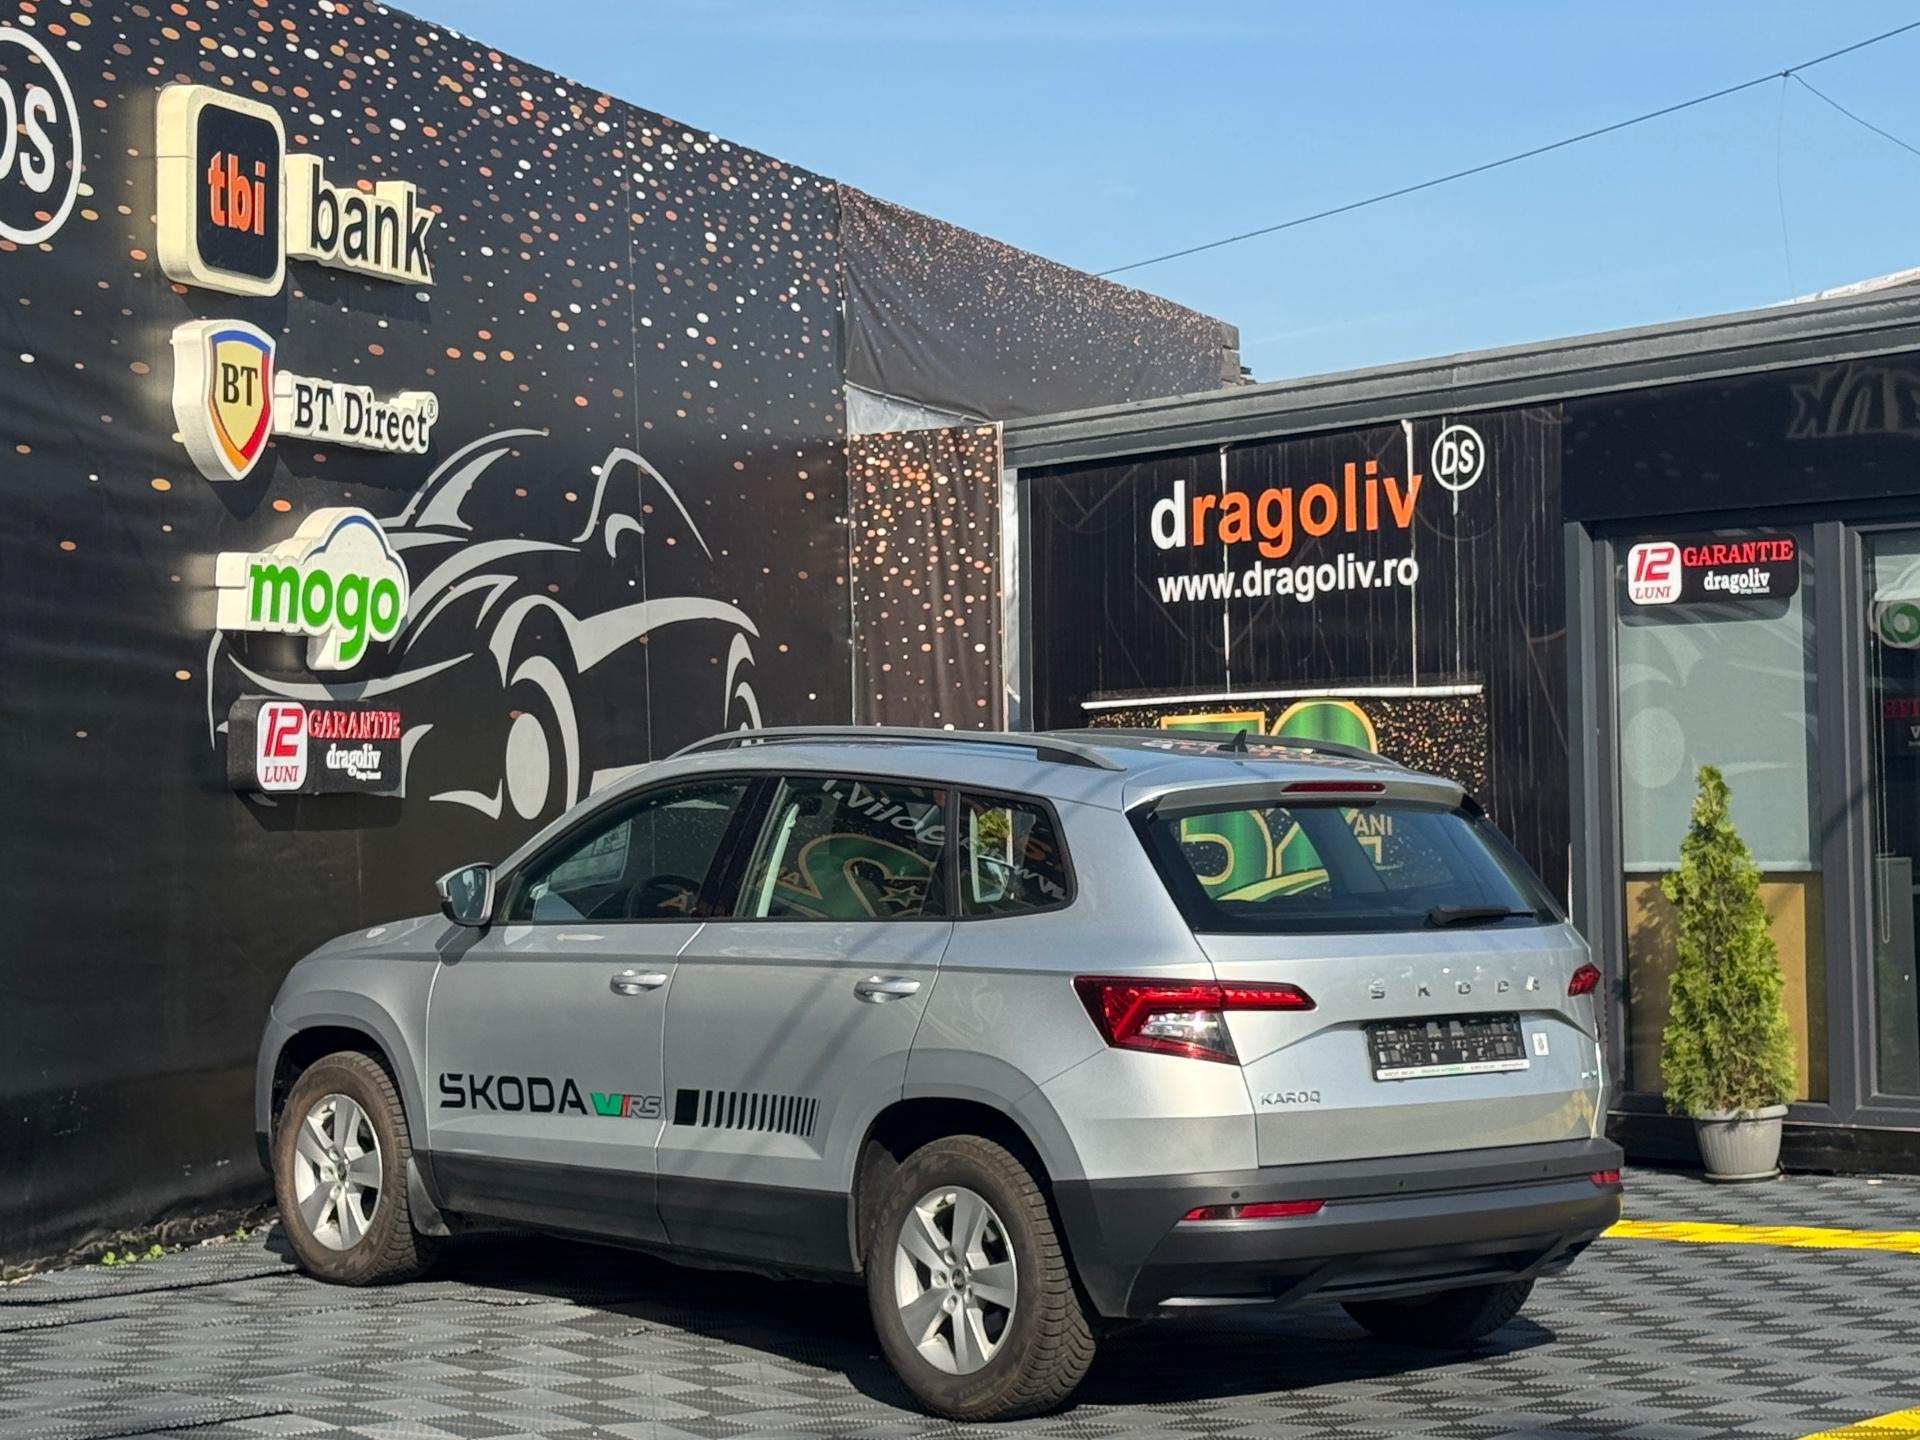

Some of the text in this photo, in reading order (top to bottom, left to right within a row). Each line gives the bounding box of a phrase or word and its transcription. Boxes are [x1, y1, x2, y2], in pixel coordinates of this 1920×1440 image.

[208, 151, 433, 277] tbi bank
[221, 362, 258, 407] BT
[295, 383, 334, 431] BT
[1441, 439, 1475, 474] DS
[1150, 460, 1422, 559] dragoliv
[1634, 547, 1675, 582] 12
[1682, 540, 1794, 567] GARANTIE
[1157, 552, 1420, 604] www.dragoliv.ro
[1635, 585, 1671, 600] LUNI
[1703, 567, 1770, 594] dragoliv
[249, 563, 400, 662] mogo
[263, 708, 302, 758] 12
[308, 709, 400, 740] GARANTIE
[263, 764, 300, 784] LUNI
[326, 743, 381, 777] dragoliv
[1353, 813, 1392, 836] ANI
[1261, 1090, 1321, 1105] KAROQ
